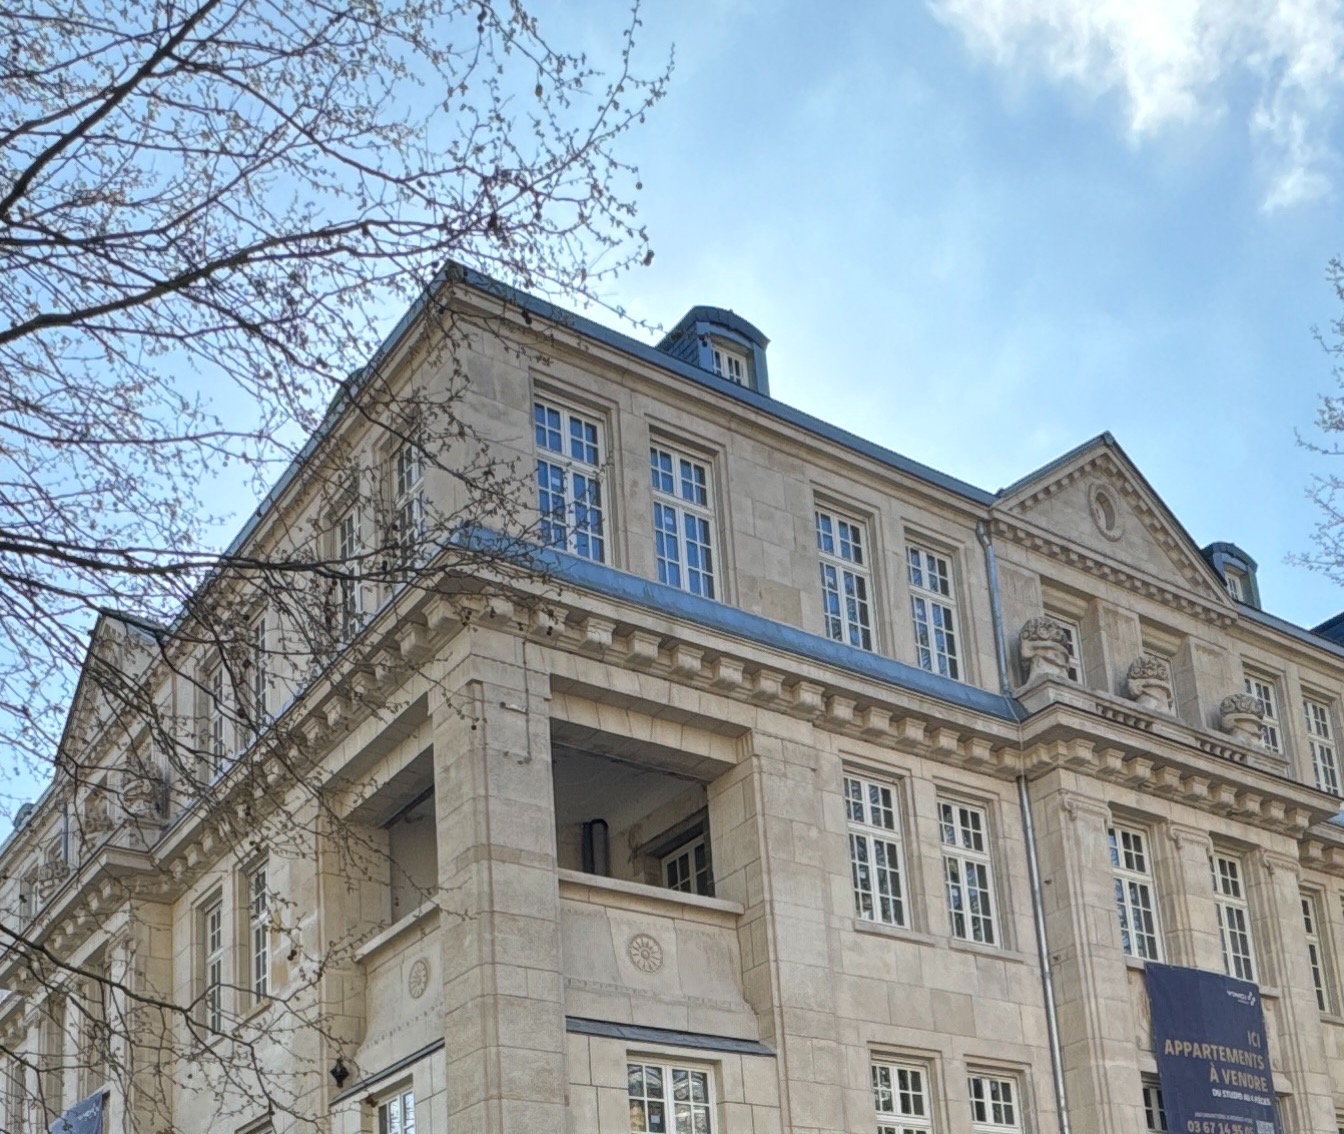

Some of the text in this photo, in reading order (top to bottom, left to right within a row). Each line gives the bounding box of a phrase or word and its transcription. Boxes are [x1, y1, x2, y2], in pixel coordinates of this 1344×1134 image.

[1247, 1030, 1261, 1049] ICI
[1164, 1039, 1265, 1070] APPARTEMENTS
[1210, 1061, 1269, 1093] À VENDRE
[1187, 1120, 1201, 1133] 03
[1202, 1121, 1215, 1134] 67
[1217, 1122, 1231, 1134] 14
